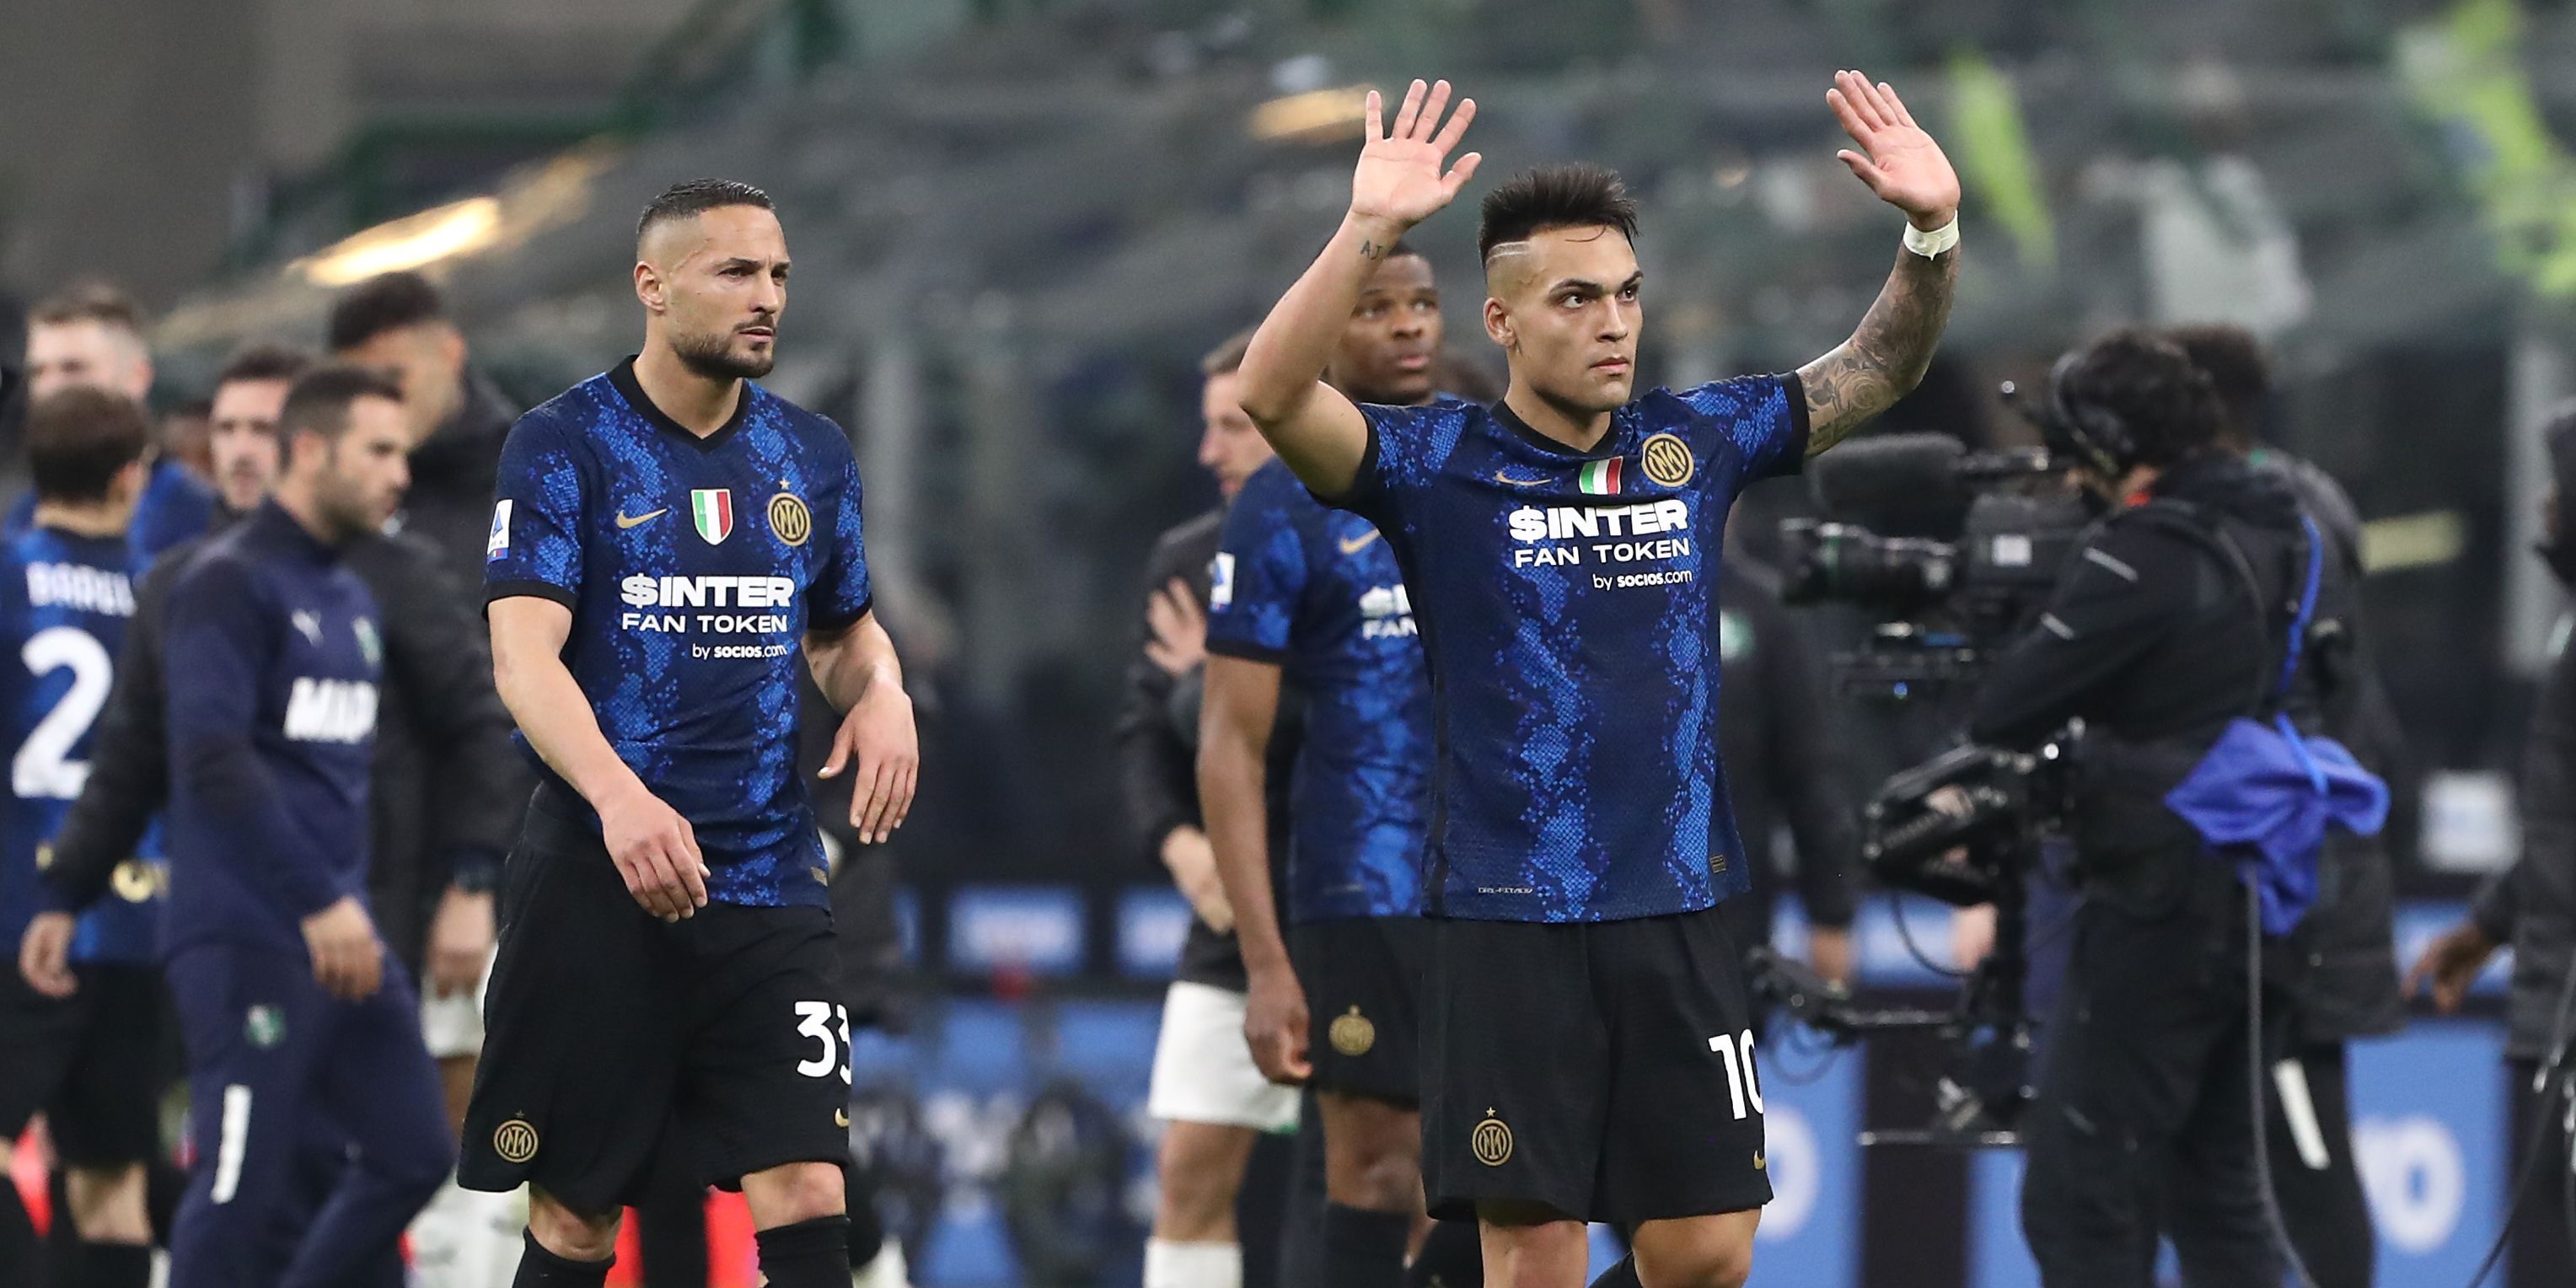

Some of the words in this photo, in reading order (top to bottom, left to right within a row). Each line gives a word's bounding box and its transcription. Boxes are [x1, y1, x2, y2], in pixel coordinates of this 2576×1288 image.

[1508, 499, 1688, 545] $INTER
[1515, 546, 1580, 568] FAN
[1592, 538, 1690, 563] TOKEN
[620, 572, 795, 609] $INTER
[1592, 573, 1613, 591] by
[1618, 570, 1693, 588] socios.com
[620, 613, 686, 632] FAN
[696, 614, 787, 633] TOKEN
[692, 643, 711, 660] by
[714, 644, 787, 658] socios.com
[12, 625, 114, 799] 2
